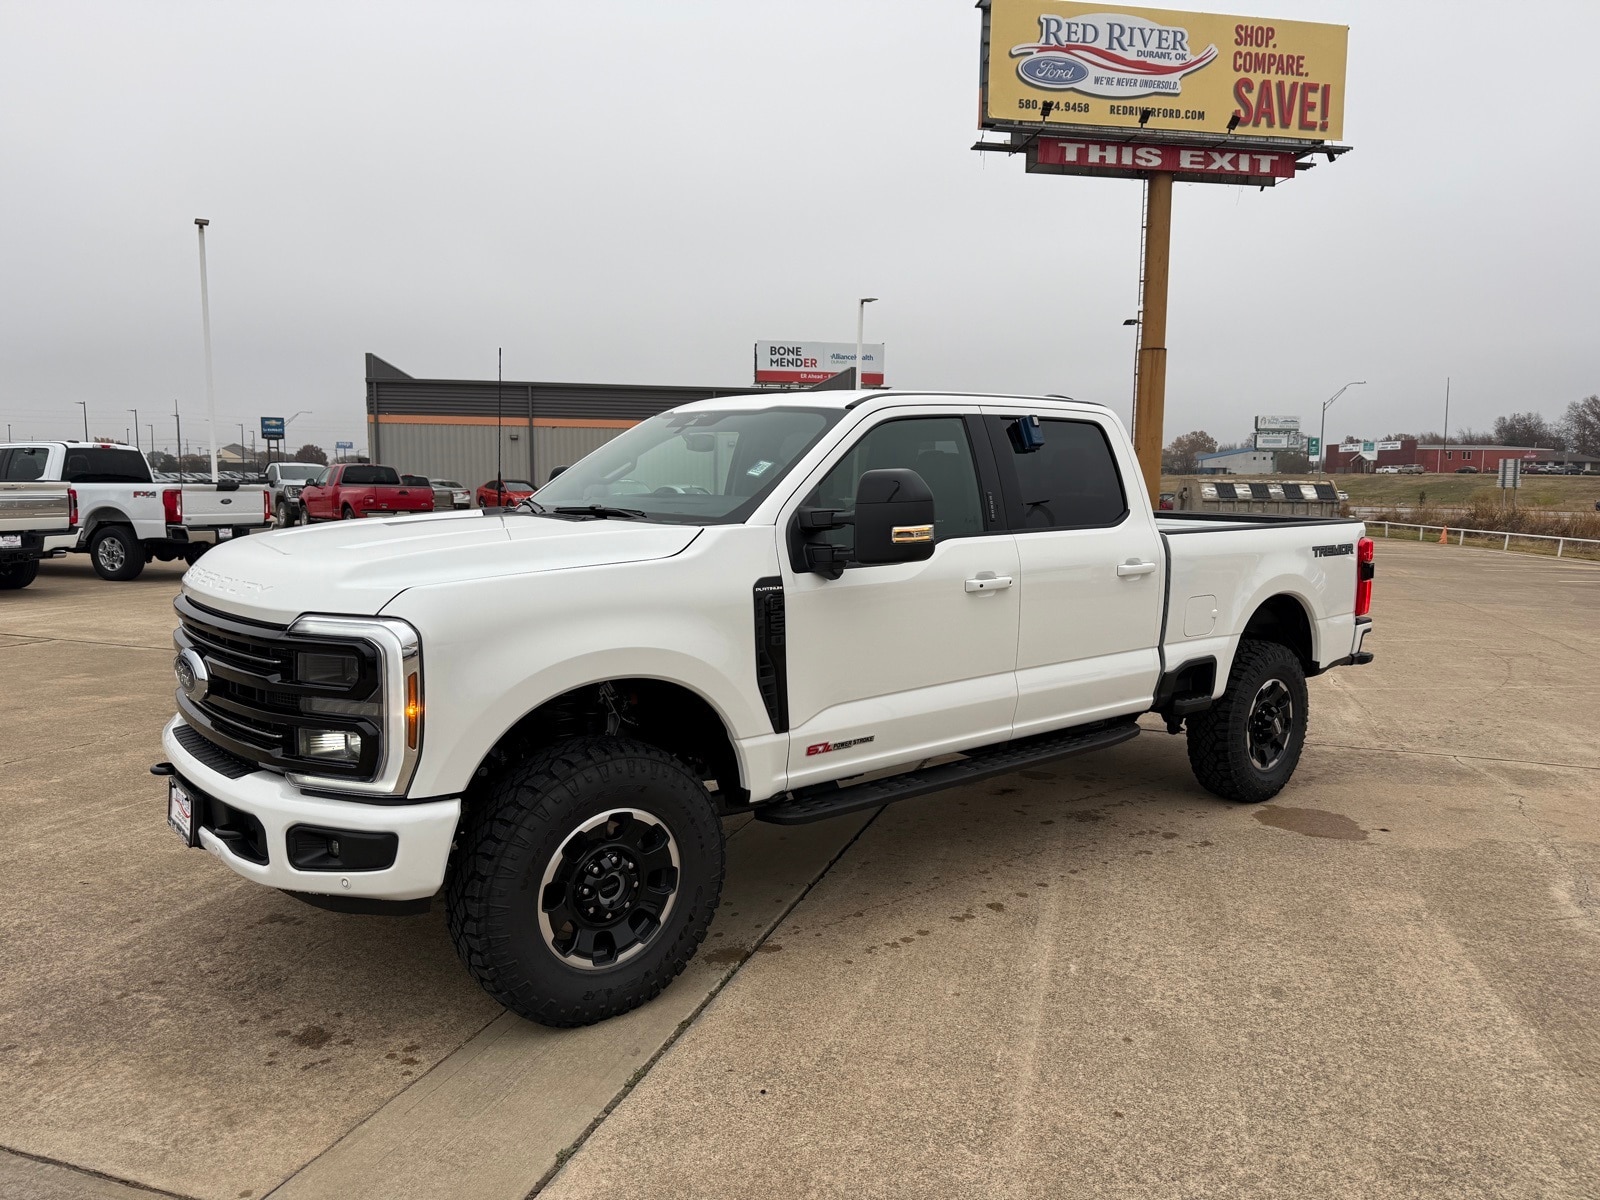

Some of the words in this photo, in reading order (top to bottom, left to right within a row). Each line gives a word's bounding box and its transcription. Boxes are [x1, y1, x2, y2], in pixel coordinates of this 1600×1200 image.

[1042, 17, 1100, 46] RED
[1105, 23, 1188, 51] RIVER
[1234, 24, 1277, 49] SHOP.
[1136, 50, 1172, 61] DURANT,
[1174, 52, 1187, 61] OK
[1233, 50, 1309, 77] COMPARE.
[1036, 59, 1074, 79] Ford
[1094, 76, 1115, 86] WE'RE
[1116, 77, 1138, 87] NEVER
[1139, 79, 1179, 90] UNDERSOLD.
[1018, 98, 1090, 113] 580.24.9458
[1233, 77, 1331, 130] SAVE!
[1109, 104, 1205, 121] REDRIVRFORD.COM
[1058, 142, 1162, 167] THIS
[1179, 150, 1279, 173] EXIT
[770, 346, 802, 356] BONE
[770, 358, 817, 368] MENDER
[133, 490, 157, 498] FX4
[1312, 543, 1354, 558] TREMOR
